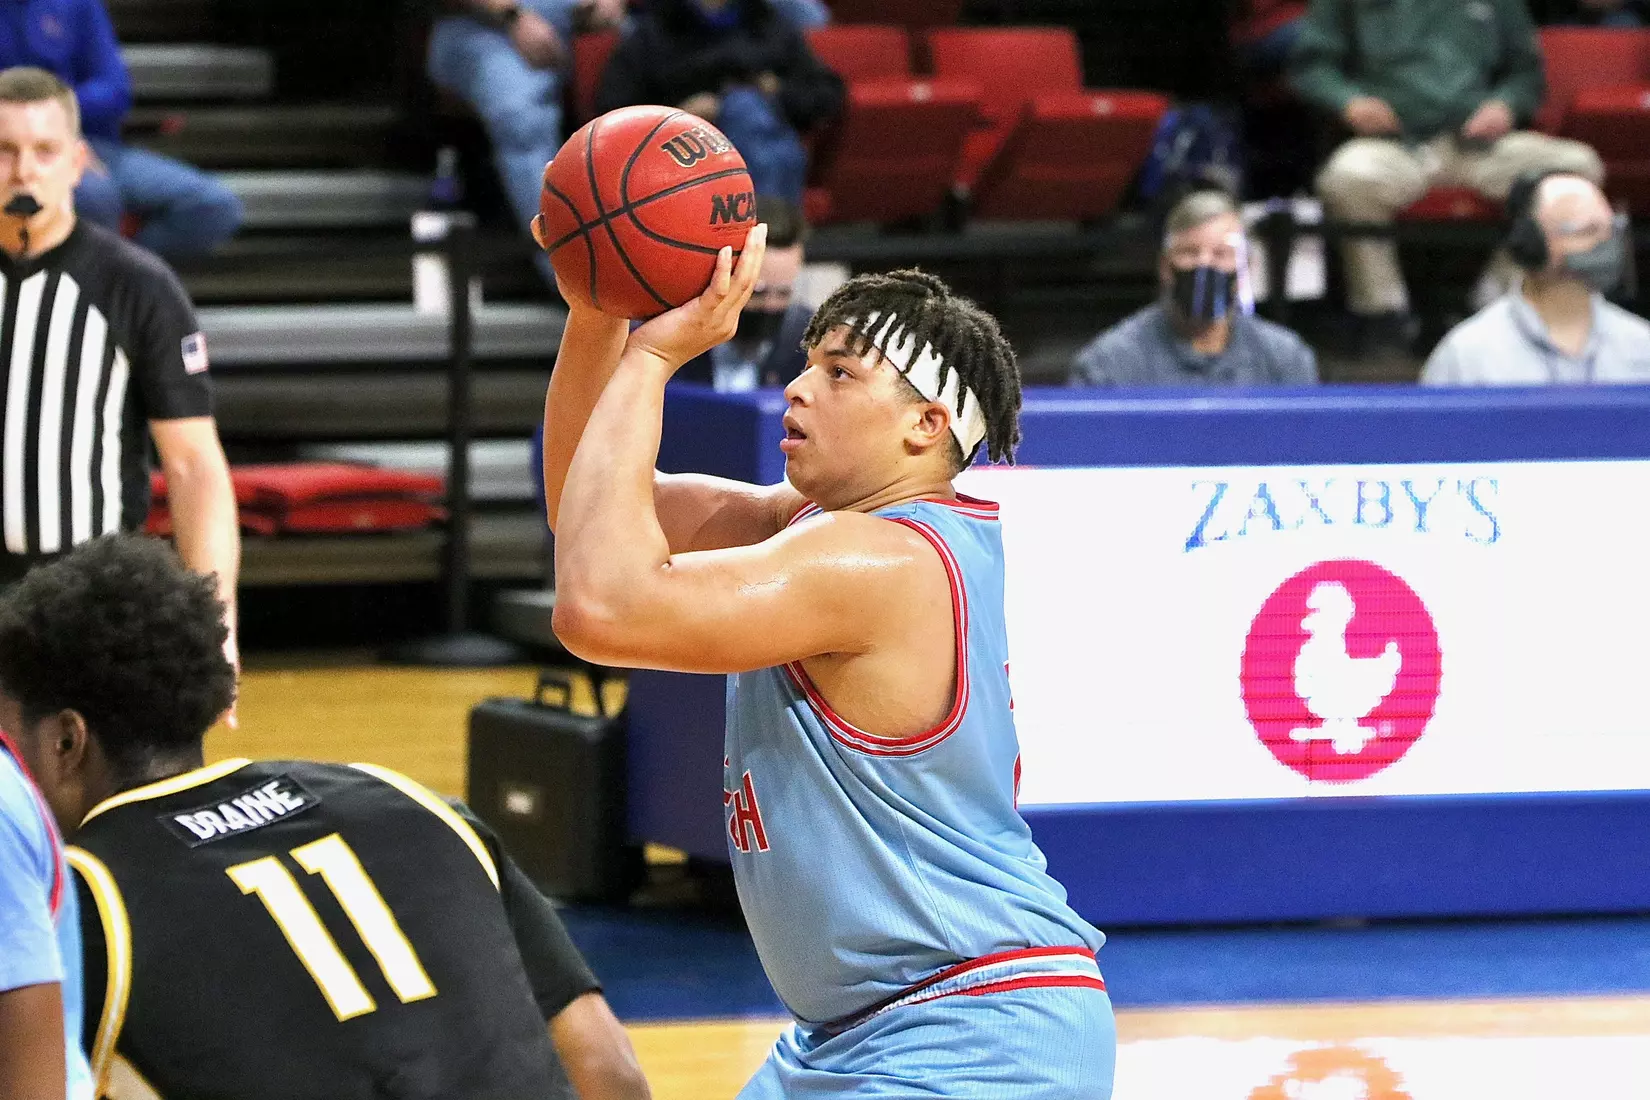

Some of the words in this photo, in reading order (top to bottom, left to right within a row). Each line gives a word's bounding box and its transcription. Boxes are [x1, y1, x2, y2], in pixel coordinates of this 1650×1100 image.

[709, 191, 757, 225] NCA
[1182, 477, 1501, 553] ZAXBY'S
[174, 780, 304, 840] DRAINE
[225, 832, 438, 1022] 11
